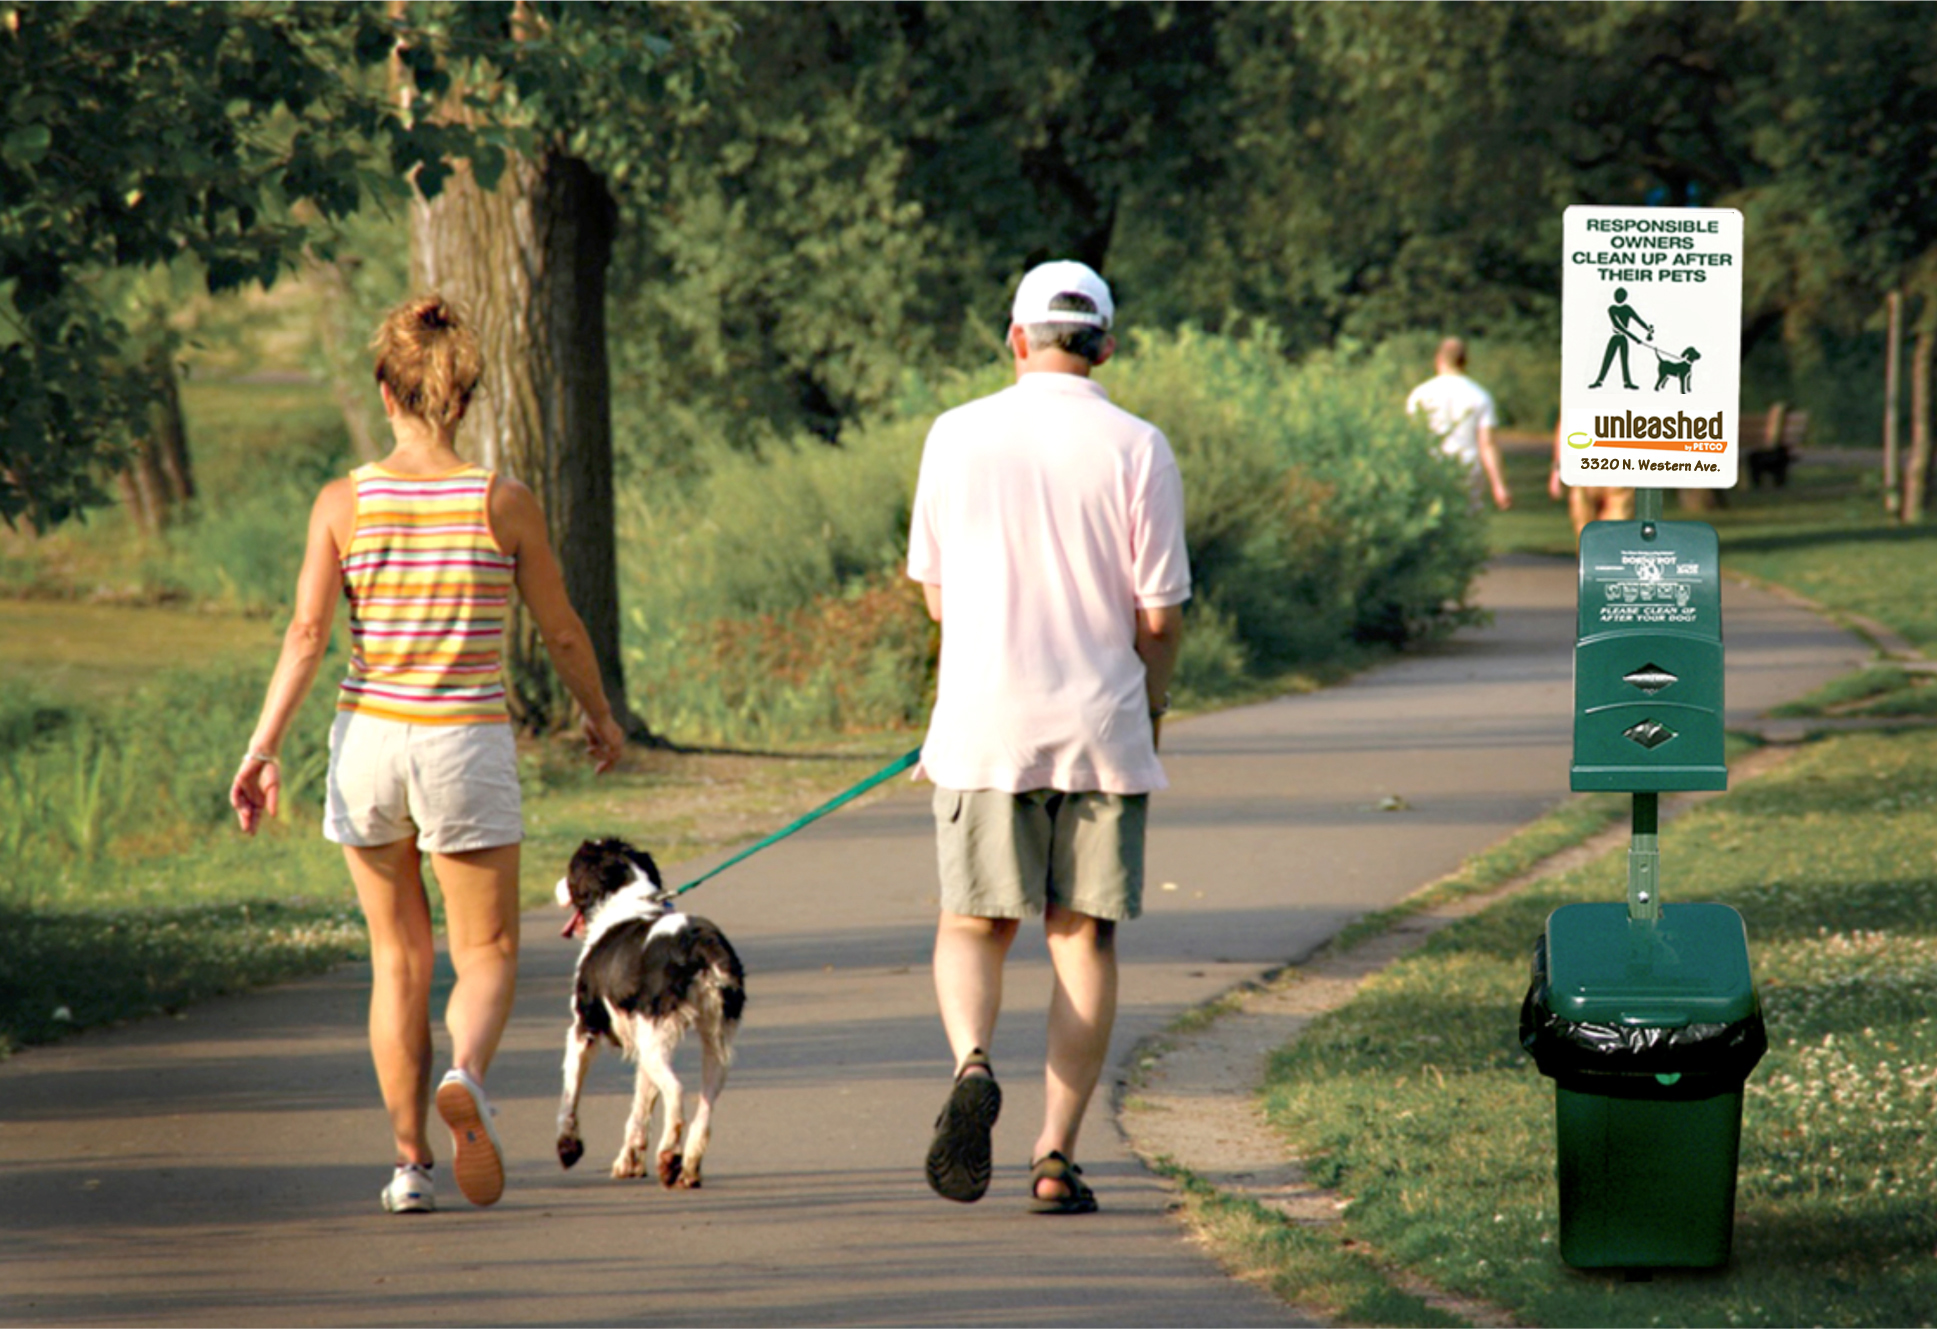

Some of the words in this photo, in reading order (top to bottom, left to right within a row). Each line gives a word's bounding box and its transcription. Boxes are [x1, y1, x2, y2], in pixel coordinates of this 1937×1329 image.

[1586, 218, 1719, 233] RESPONSIBLE
[1610, 236, 1694, 249] OWNERS
[1571, 251, 1636, 265] CLEAN
[1641, 252, 1668, 265] UP
[1672, 253, 1733, 266] AFTER
[1597, 268, 1653, 282] THEIR
[1658, 269, 1707, 282] PETS
[1594, 409, 1723, 439] unleashed
[1684, 444, 1693, 452] by
[1693, 442, 1723, 451] PETCO
[1580, 458, 1620, 470] 3320
[1622, 459, 1635, 471] N.
[1638, 459, 1692, 472] Western
[1693, 460, 1721, 472] Ave.
